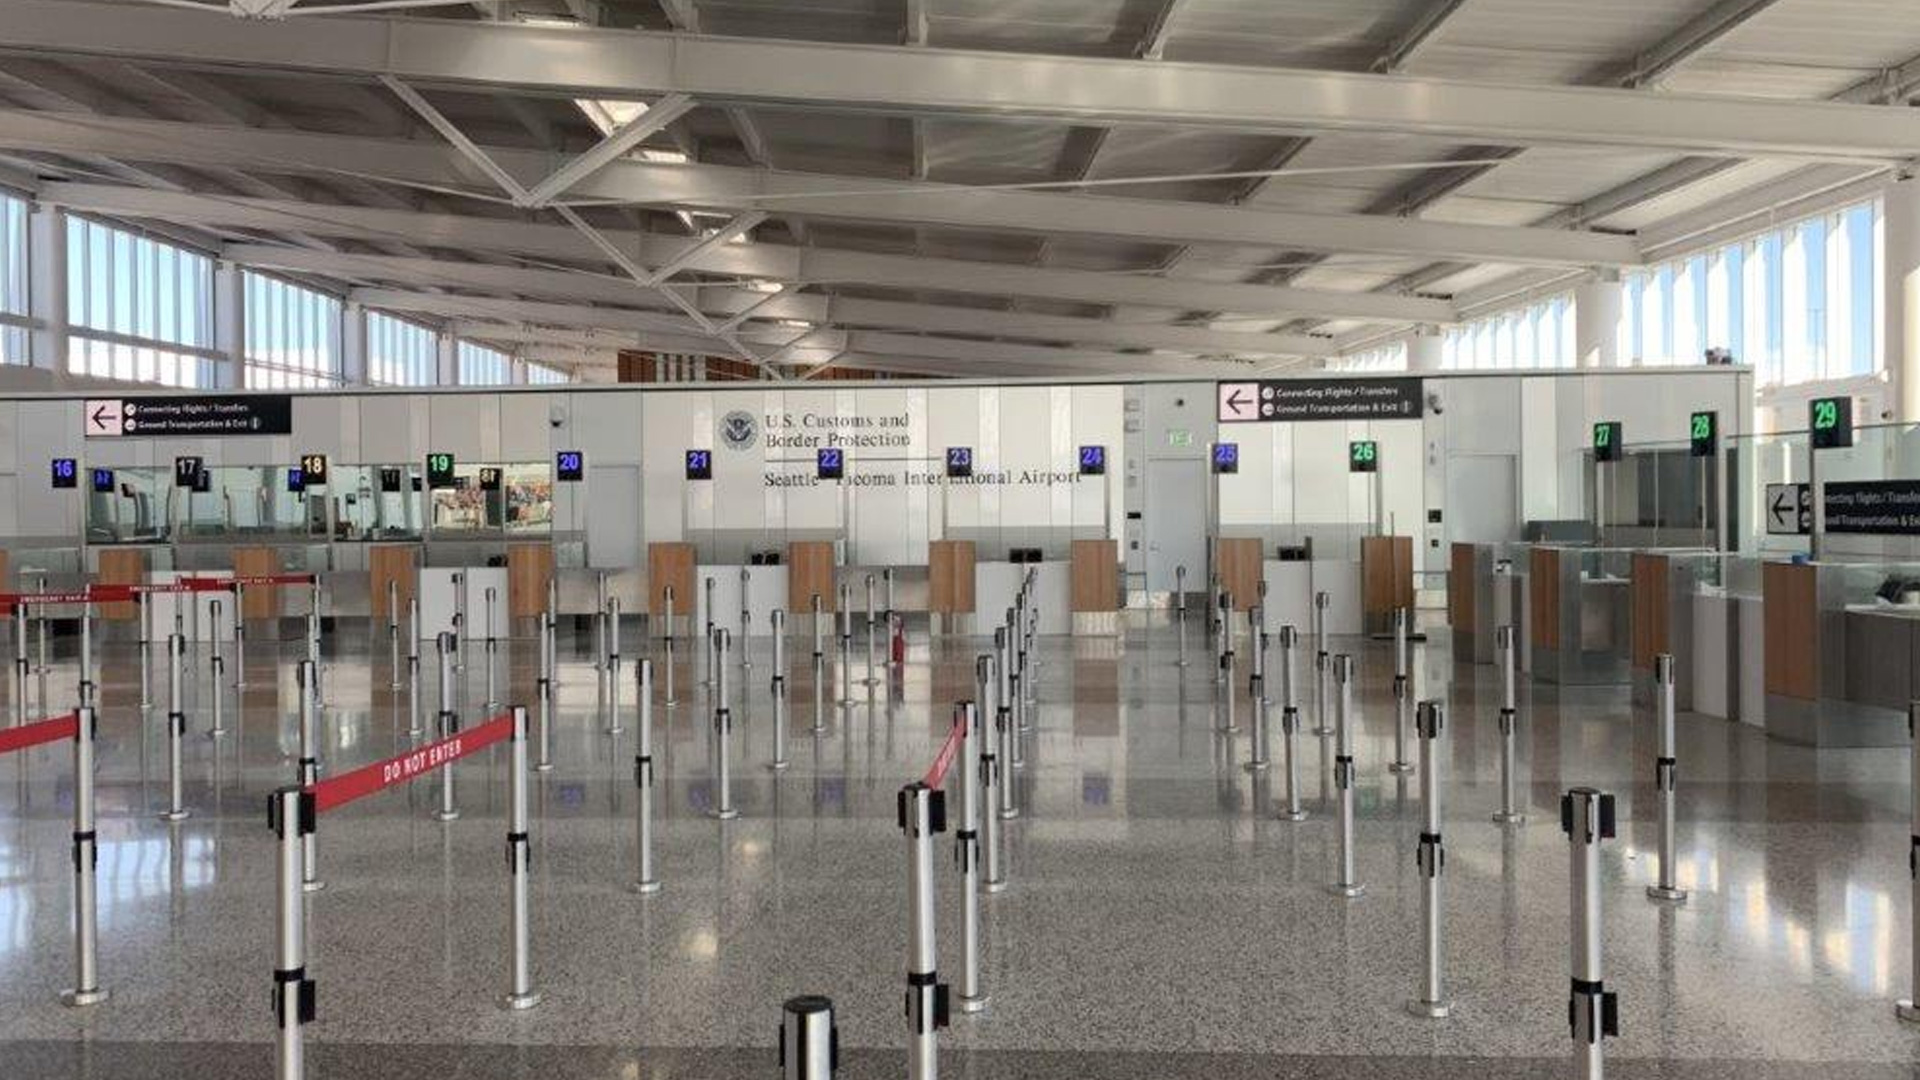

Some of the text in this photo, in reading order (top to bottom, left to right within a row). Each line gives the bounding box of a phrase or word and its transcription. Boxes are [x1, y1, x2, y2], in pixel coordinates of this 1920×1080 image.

[1276, 388, 1323, 398] Connecting
[1325, 387, 1352, 399] Flights
[1360, 386, 1398, 396] Transfers
[1309, 404, 1371, 415] Transportation
[1815, 401, 1837, 428] 29
[766, 412, 909, 428] U.S. Customs and
[1692, 415, 1710, 440] 28
[766, 433, 911, 448] Border Protection
[1597, 426, 1610, 448] 27
[689, 452, 708, 469] 21
[821, 450, 840, 468] 22
[951, 448, 970, 466] 23
[1215, 445, 1236, 464] 25
[1353, 444, 1374, 461] 26
[55, 460, 73, 477] 16
[178, 459, 196, 475] 17
[304, 457, 323, 474] 18
[430, 456, 449, 471] 19
[559, 454, 580, 470] 20
[764, 472, 820, 487] Seattle
[1018, 470, 1082, 487] Airport
[383, 739, 461, 783] DO NOT ENTER
